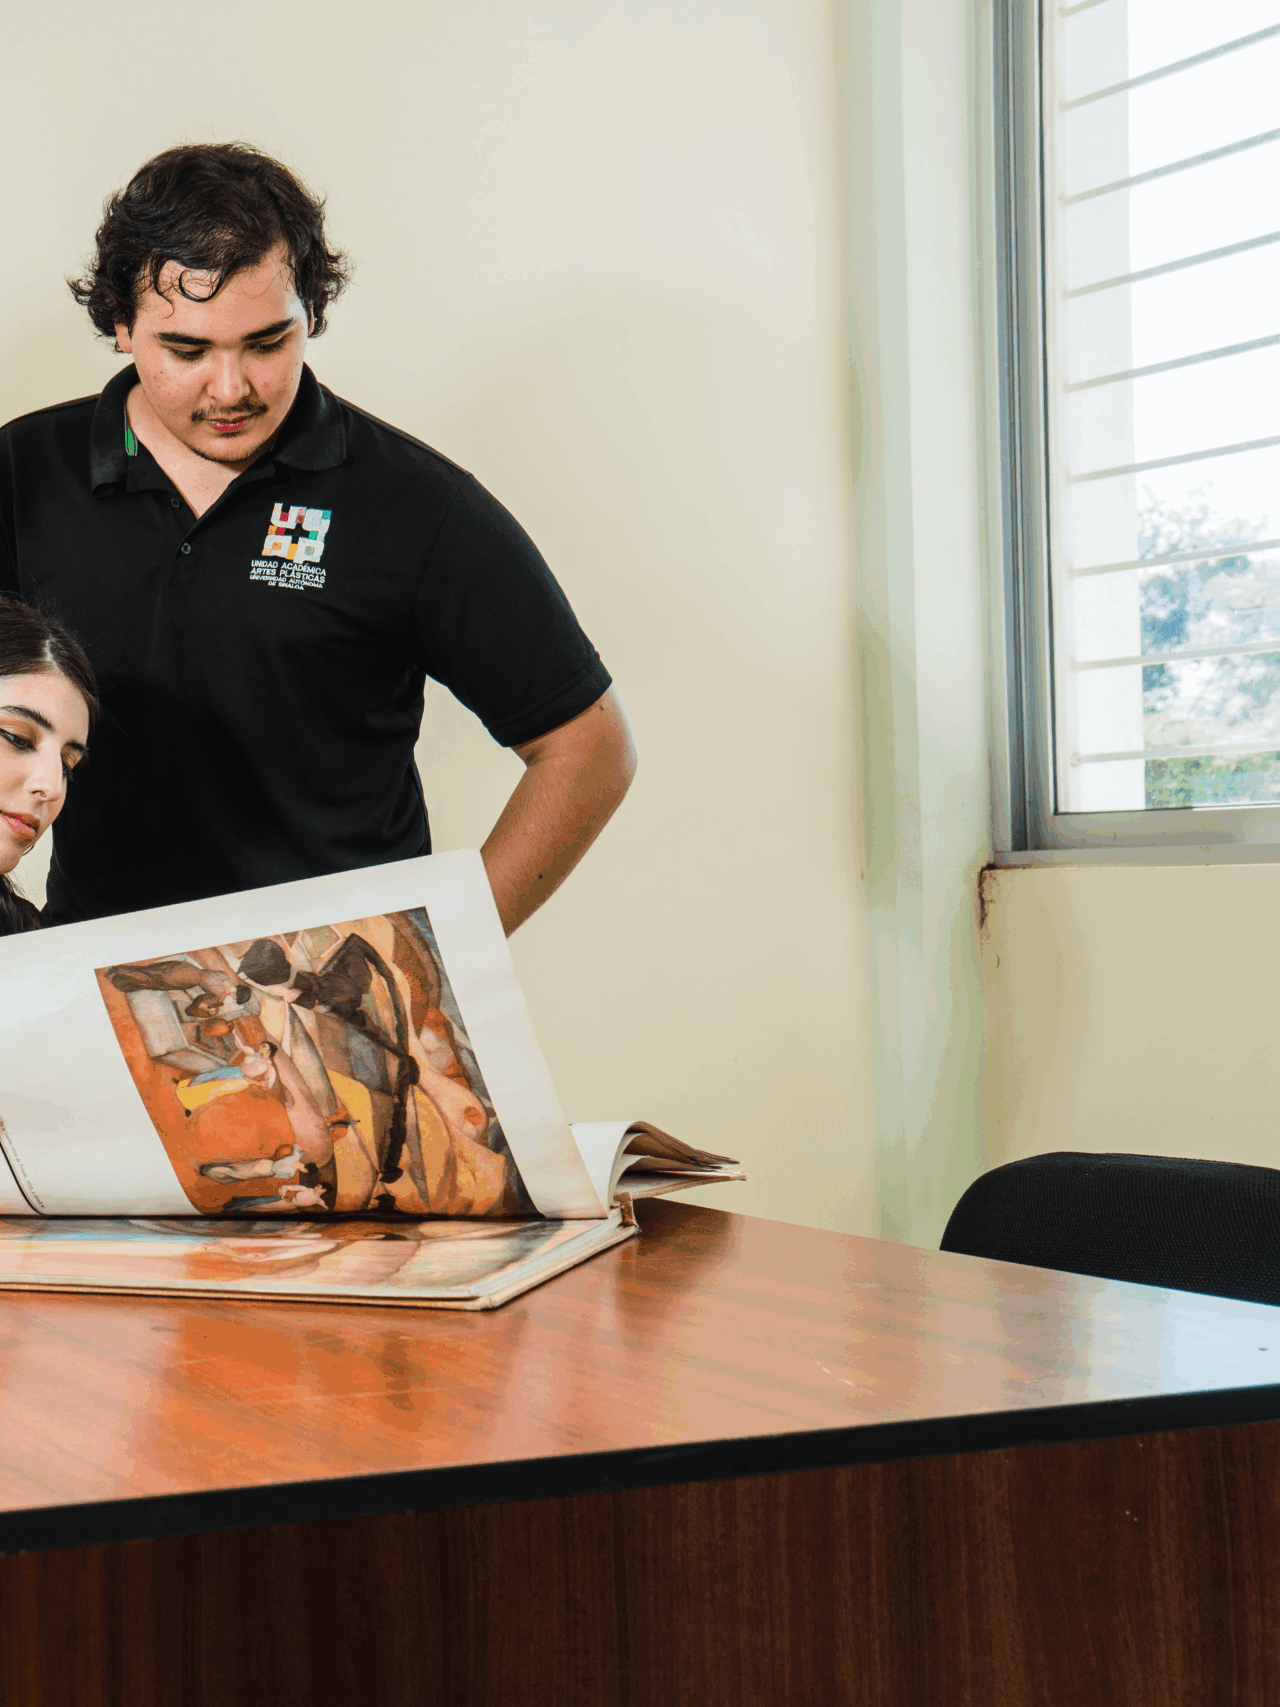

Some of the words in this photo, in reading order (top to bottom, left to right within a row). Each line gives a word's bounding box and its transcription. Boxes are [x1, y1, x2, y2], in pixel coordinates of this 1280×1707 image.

[250, 567, 277, 576] ARTES
[279, 569, 326, 584] PLÁSTICAS
[251, 559, 279, 568] UNIDAD
[281, 562, 327, 577] ACADÉMICA
[278, 581, 305, 591] SINALOA
